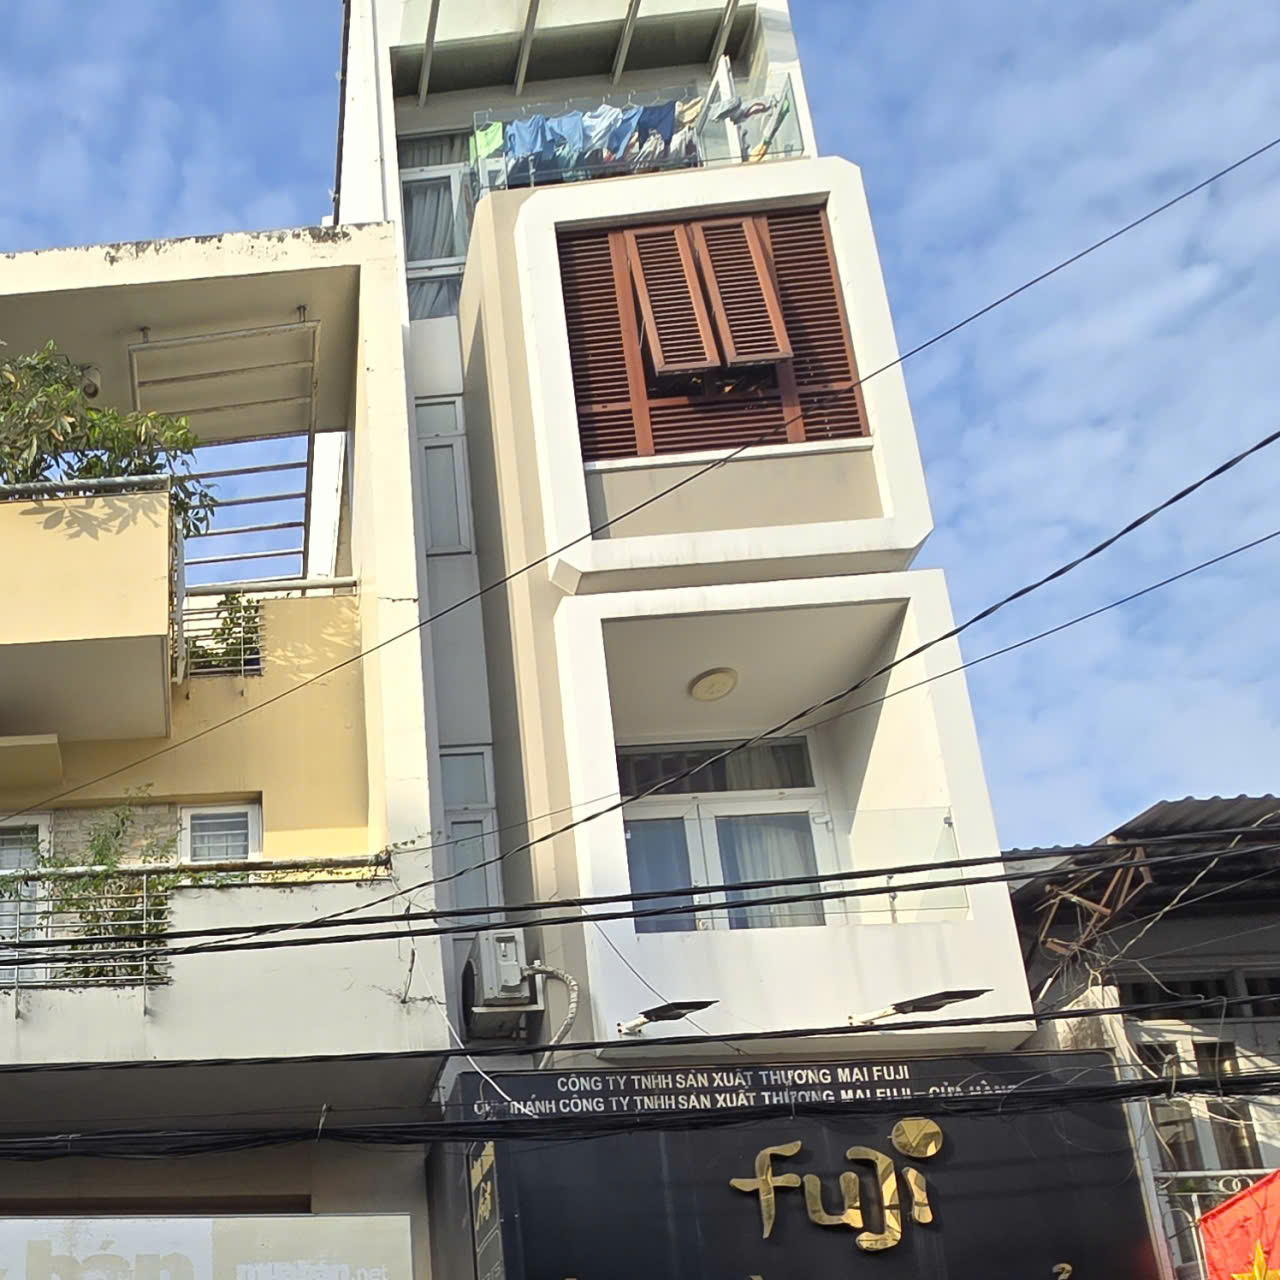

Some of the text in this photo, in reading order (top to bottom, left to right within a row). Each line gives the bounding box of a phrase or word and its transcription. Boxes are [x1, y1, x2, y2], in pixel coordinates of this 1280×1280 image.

[557, 1074, 602, 1091] CÔNG
[606, 1076, 627, 1090] TY
[631, 1074, 672, 1089] TNHH
[837, 1066, 869, 1085] MẠI
[872, 1065, 910, 1081] FUJI
[559, 1095, 604, 1113] CÔNG
[608, 1098, 630, 1112] TY
[635, 1096, 675, 1112] TNHH
